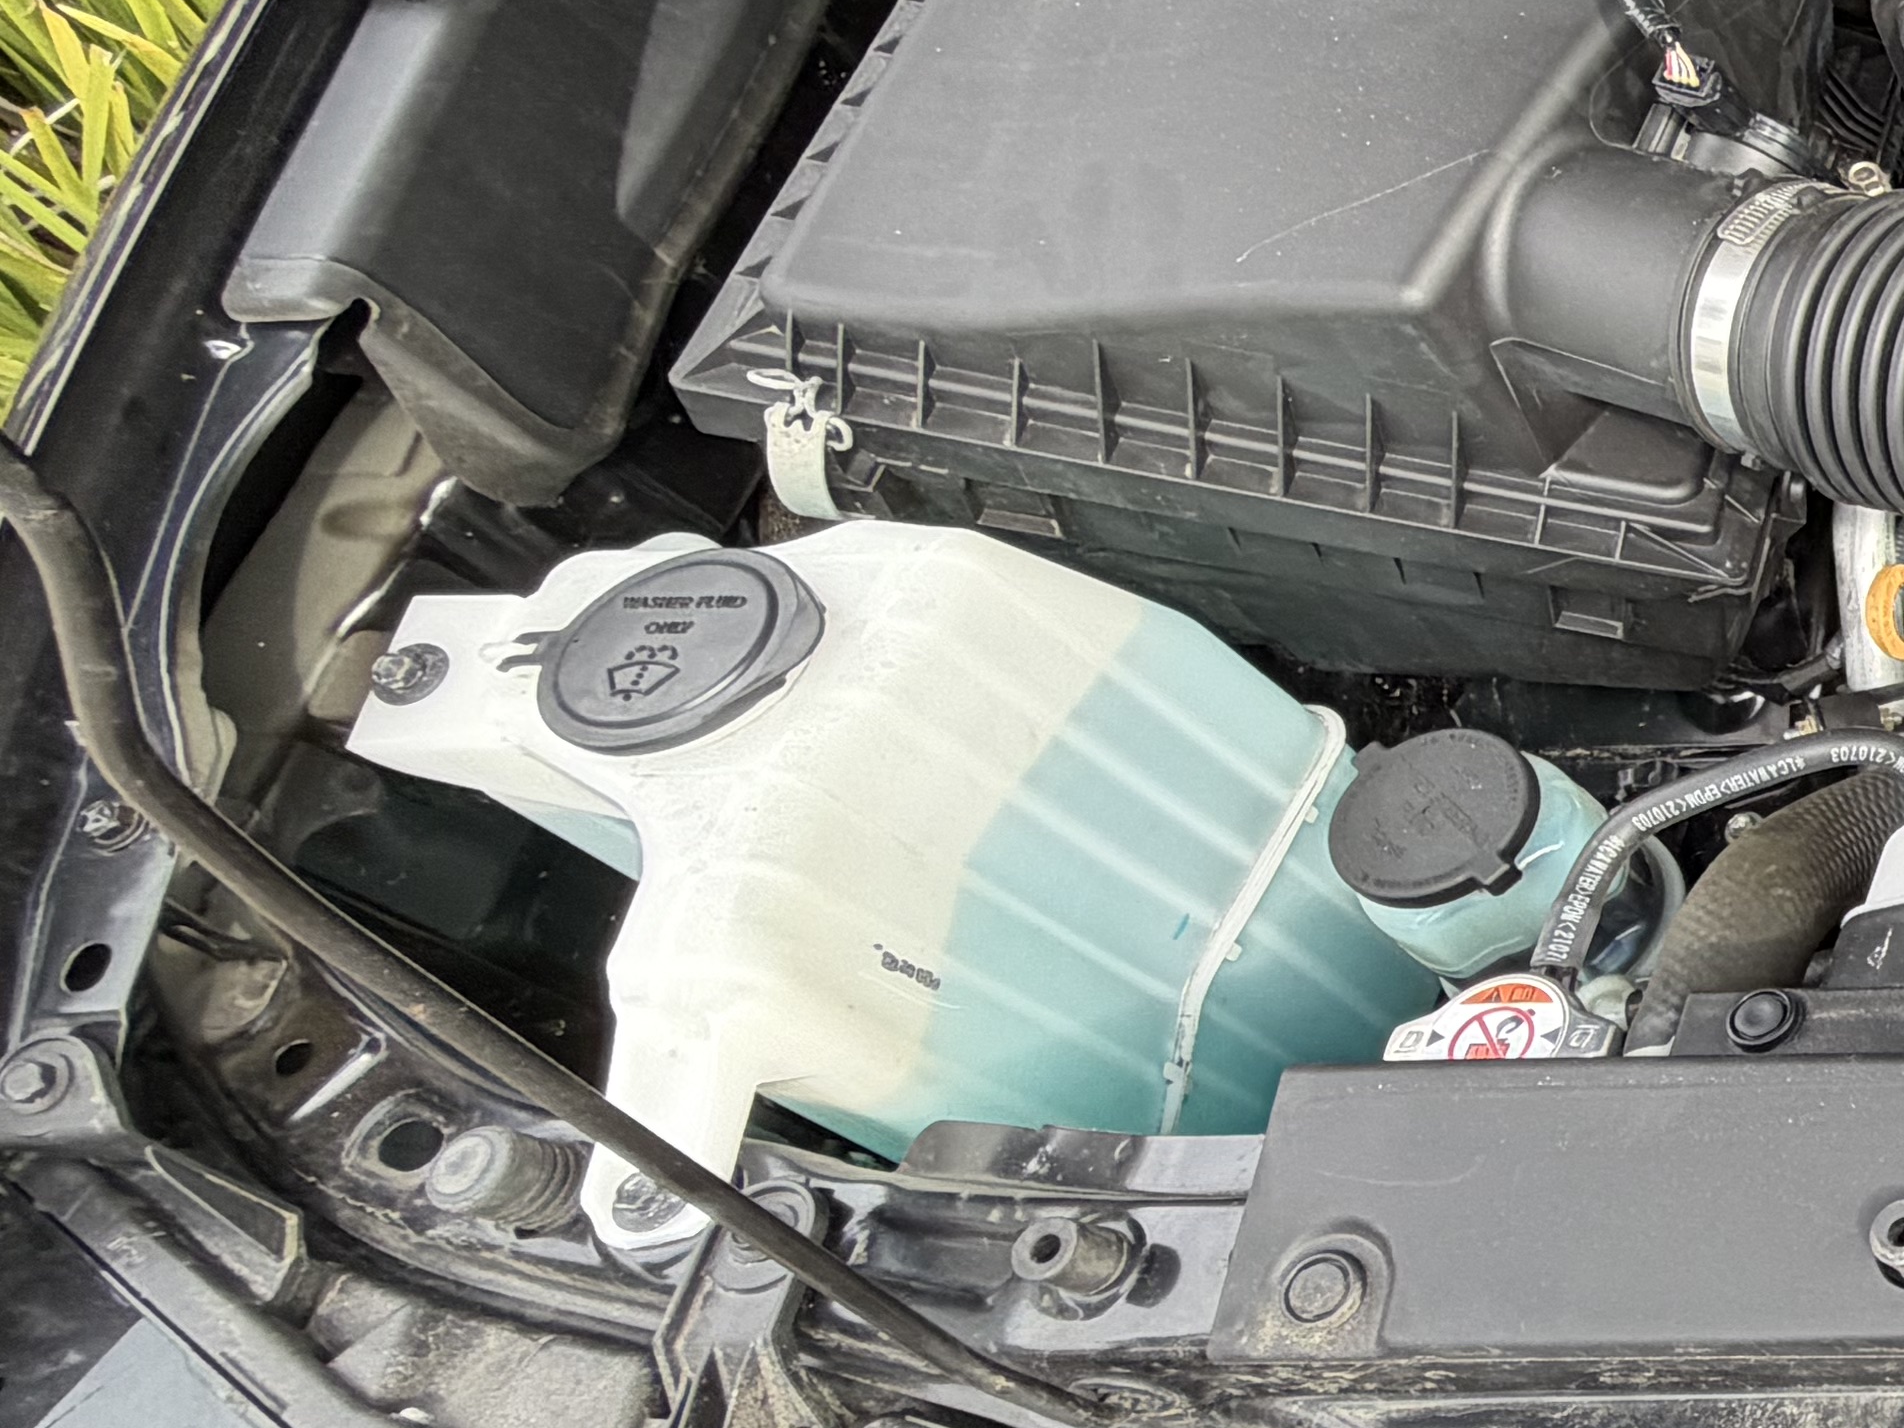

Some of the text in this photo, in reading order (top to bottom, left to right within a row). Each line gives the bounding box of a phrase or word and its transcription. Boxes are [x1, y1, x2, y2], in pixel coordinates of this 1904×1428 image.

[622, 595, 748, 610] WASHER FLUID
[644, 620, 695, 635] ONLY
